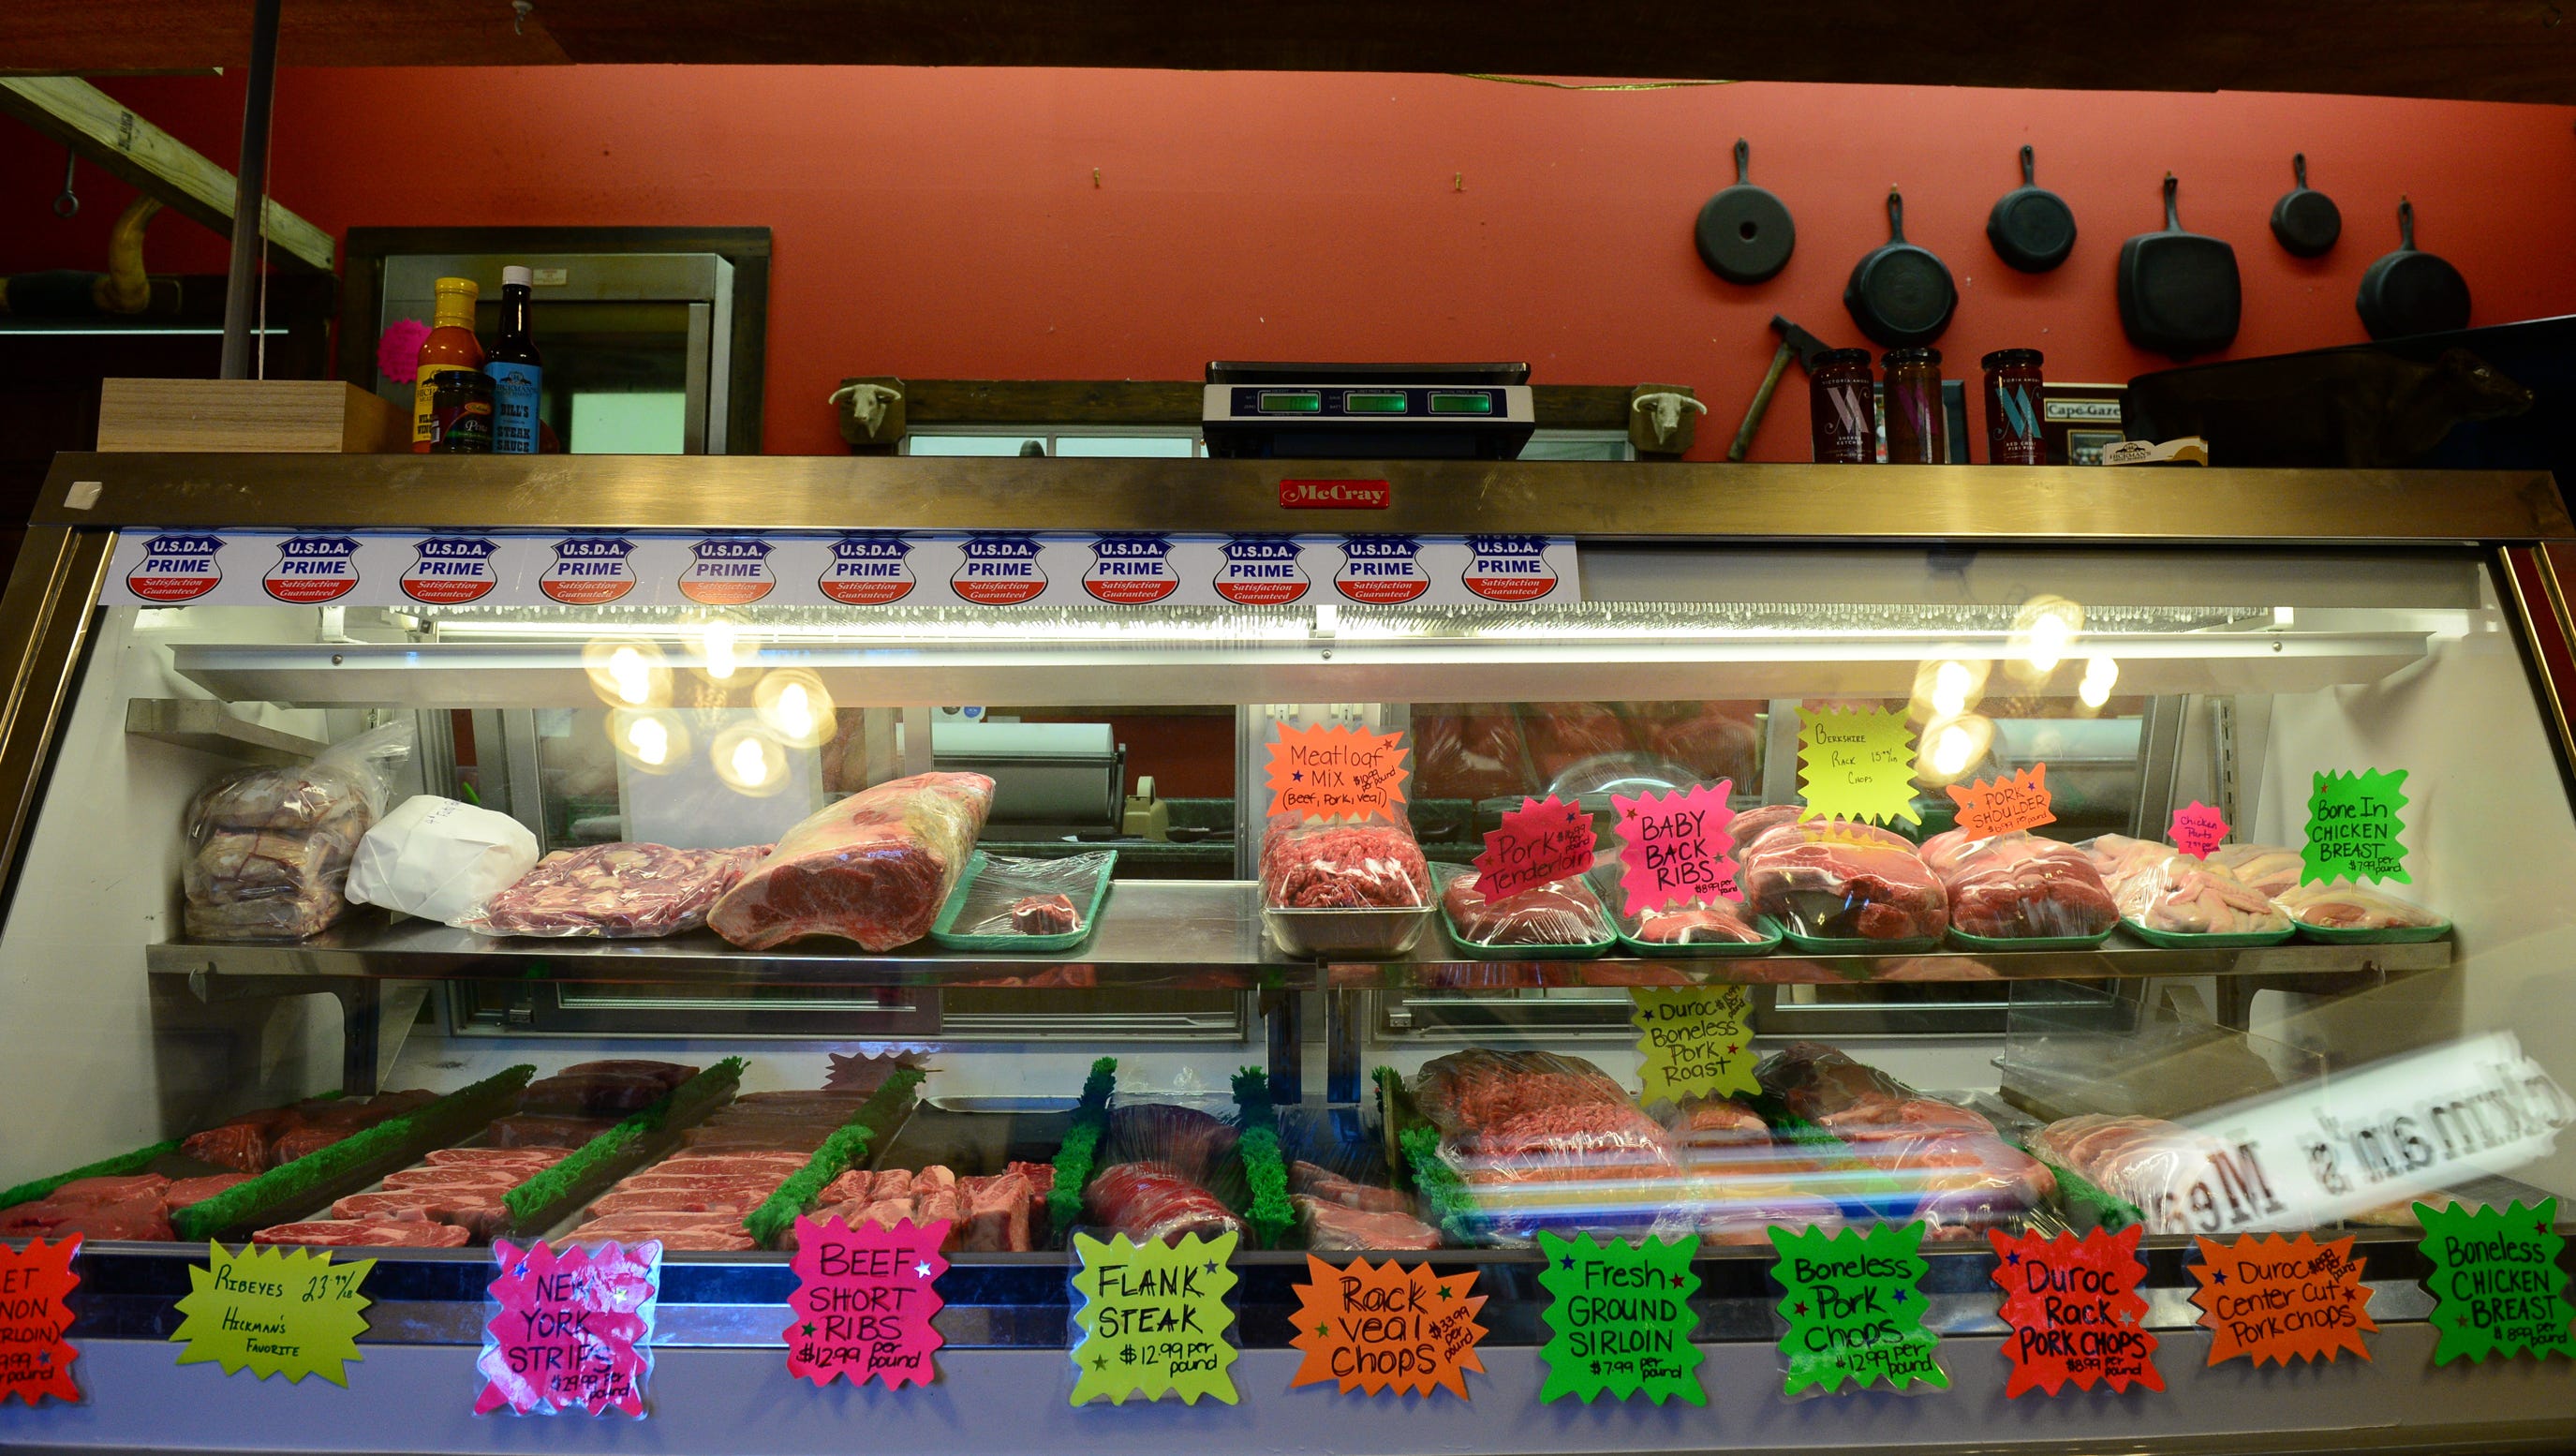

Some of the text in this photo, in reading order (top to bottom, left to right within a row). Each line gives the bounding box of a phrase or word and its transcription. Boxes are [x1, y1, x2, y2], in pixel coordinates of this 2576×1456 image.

[2048, 404, 2084, 418] Cape
[496, 426, 530, 438] STEAK
[496, 440, 530, 453] SAUCE
[1281, 484, 1385, 505] McCray
[153, 540, 214, 553] U.S.D.A.
[288, 542, 349, 555] U.S.D.A.
[424, 543, 487, 557] U.S.D.A.
[562, 543, 625, 556] U.S.D.A.
[701, 544, 762, 557] U.S.D.A.
[839, 544, 901, 557] U.S.D.A.
[970, 543, 1032, 557] U.S.D.A.
[1101, 543, 1163, 556] U.S.D.A.
[1230, 545, 1294, 558] U.S.D.A.
[1349, 543, 1413, 557] U.S.D.A.
[1476, 542, 1539, 554] U.S.D.A.
[145, 558, 211, 573] PRIME
[281, 560, 347, 574] PRIME
[418, 562, 484, 575] PRIME
[557, 562, 623, 575] PRIME
[696, 563, 762, 577] PRIME
[836, 563, 901, 577] PRIME
[968, 562, 1032, 575] PRIME
[1098, 562, 1163, 575] PRIME
[1229, 564, 1295, 578] PRIME
[1349, 562, 1414, 576] PRIME
[1476, 560, 1542, 573] PRIME
[142, 578, 203, 587] Satisfaction
[142, 587, 198, 596] Guaranteed
[417, 581, 479, 590] Satisfaction
[836, 582, 898, 591] Satisfaction
[969, 581, 1030, 591] Satisfaction
[1101, 581, 1162, 590] Satisfaction
[1231, 583, 1293, 592] Satisfaction
[1353, 581, 1413, 590] Satisfaction
[1480, 579, 1541, 587] Satisfaction
[417, 590, 472, 599] Guaranteed
[837, 591, 894, 600] Guaranteed
[970, 591, 1027, 600] Guaranteed
[1233, 592, 1291, 602] Guaranteed
[1291, 745, 1384, 768] Meatloaf
[1984, 787, 2025, 810] PORK
[1972, 795, 2048, 828] SHOULDER
[2317, 796, 2388, 821] Bone In
[1641, 810, 1705, 841] BABY
[2181, 815, 2217, 830] Chicken
[2312, 823, 2387, 843] CHICKEN
[1497, 831, 1559, 864] Pork
[1646, 838, 1709, 869] BACK
[2319, 842, 2385, 862] BREAST
[2376, 862, 2402, 875] pound
[2377, 856, 2394, 865] per
[1486, 851, 1591, 894] Tenderloin
[1657, 860, 1714, 891] RIBS
[1660, 1001, 1717, 1021] Duroc
[1651, 1019, 1739, 1047] Boneless
[1667, 1041, 1720, 1066] Pork
[1662, 1056, 1731, 1087] Roast
[2445, 1230, 2546, 1268] Boneless
[820, 1242, 916, 1276] BEEF
[1585, 1259, 1666, 1290] Fresh
[1795, 1254, 1913, 1284] Boneless
[2025, 1259, 2120, 1295] Duroc
[2237, 1261, 2310, 1285] Duroc
[215, 1264, 283, 1298] RIBEYES
[1098, 1265, 1205, 1299] FLANK
[2451, 1269, 2550, 1301] CHICKEN
[809, 1285, 917, 1312] SHORT
[1339, 1276, 1429, 1315] Rack
[1808, 1285, 1888, 1319] Pork
[2216, 1280, 2340, 1321] Center Cut
[221, 1306, 286, 1334] HICKMAN'S
[1568, 1295, 1678, 1327] GROUND
[2046, 1296, 2118, 1329] Rack
[2471, 1295, 2557, 1329] BREAST
[521, 1308, 593, 1342] YORK
[824, 1315, 903, 1342] RIBS
[1098, 1304, 1204, 1338] STEAK
[2228, 1317, 2285, 1347] Pork
[2530, 1330, 2568, 1348] pound
[245, 1338, 300, 1357] FAVORITE
[872, 1342, 902, 1355] per
[1443, 1329, 1474, 1364] pound
[1568, 1329, 1673, 1358] SIRLOIN
[1893, 1344, 1927, 1359] per
[2020, 1326, 2147, 1364] PORK CHOPS
[508, 1344, 614, 1374] STRIPS
[867, 1351, 922, 1373] pound
[1118, 1342, 1214, 1366] $12.99 per
[1170, 1353, 1218, 1379] pound
[1589, 1357, 1664, 1375] $7.99 per
[1643, 1364, 1682, 1383] pound
[1888, 1353, 1933, 1378] pound
[2104, 1362, 2141, 1377] pound
[7, 1366, 54, 1384] pound
[603, 1372, 626, 1386] per
[588, 1383, 631, 1404] pound
